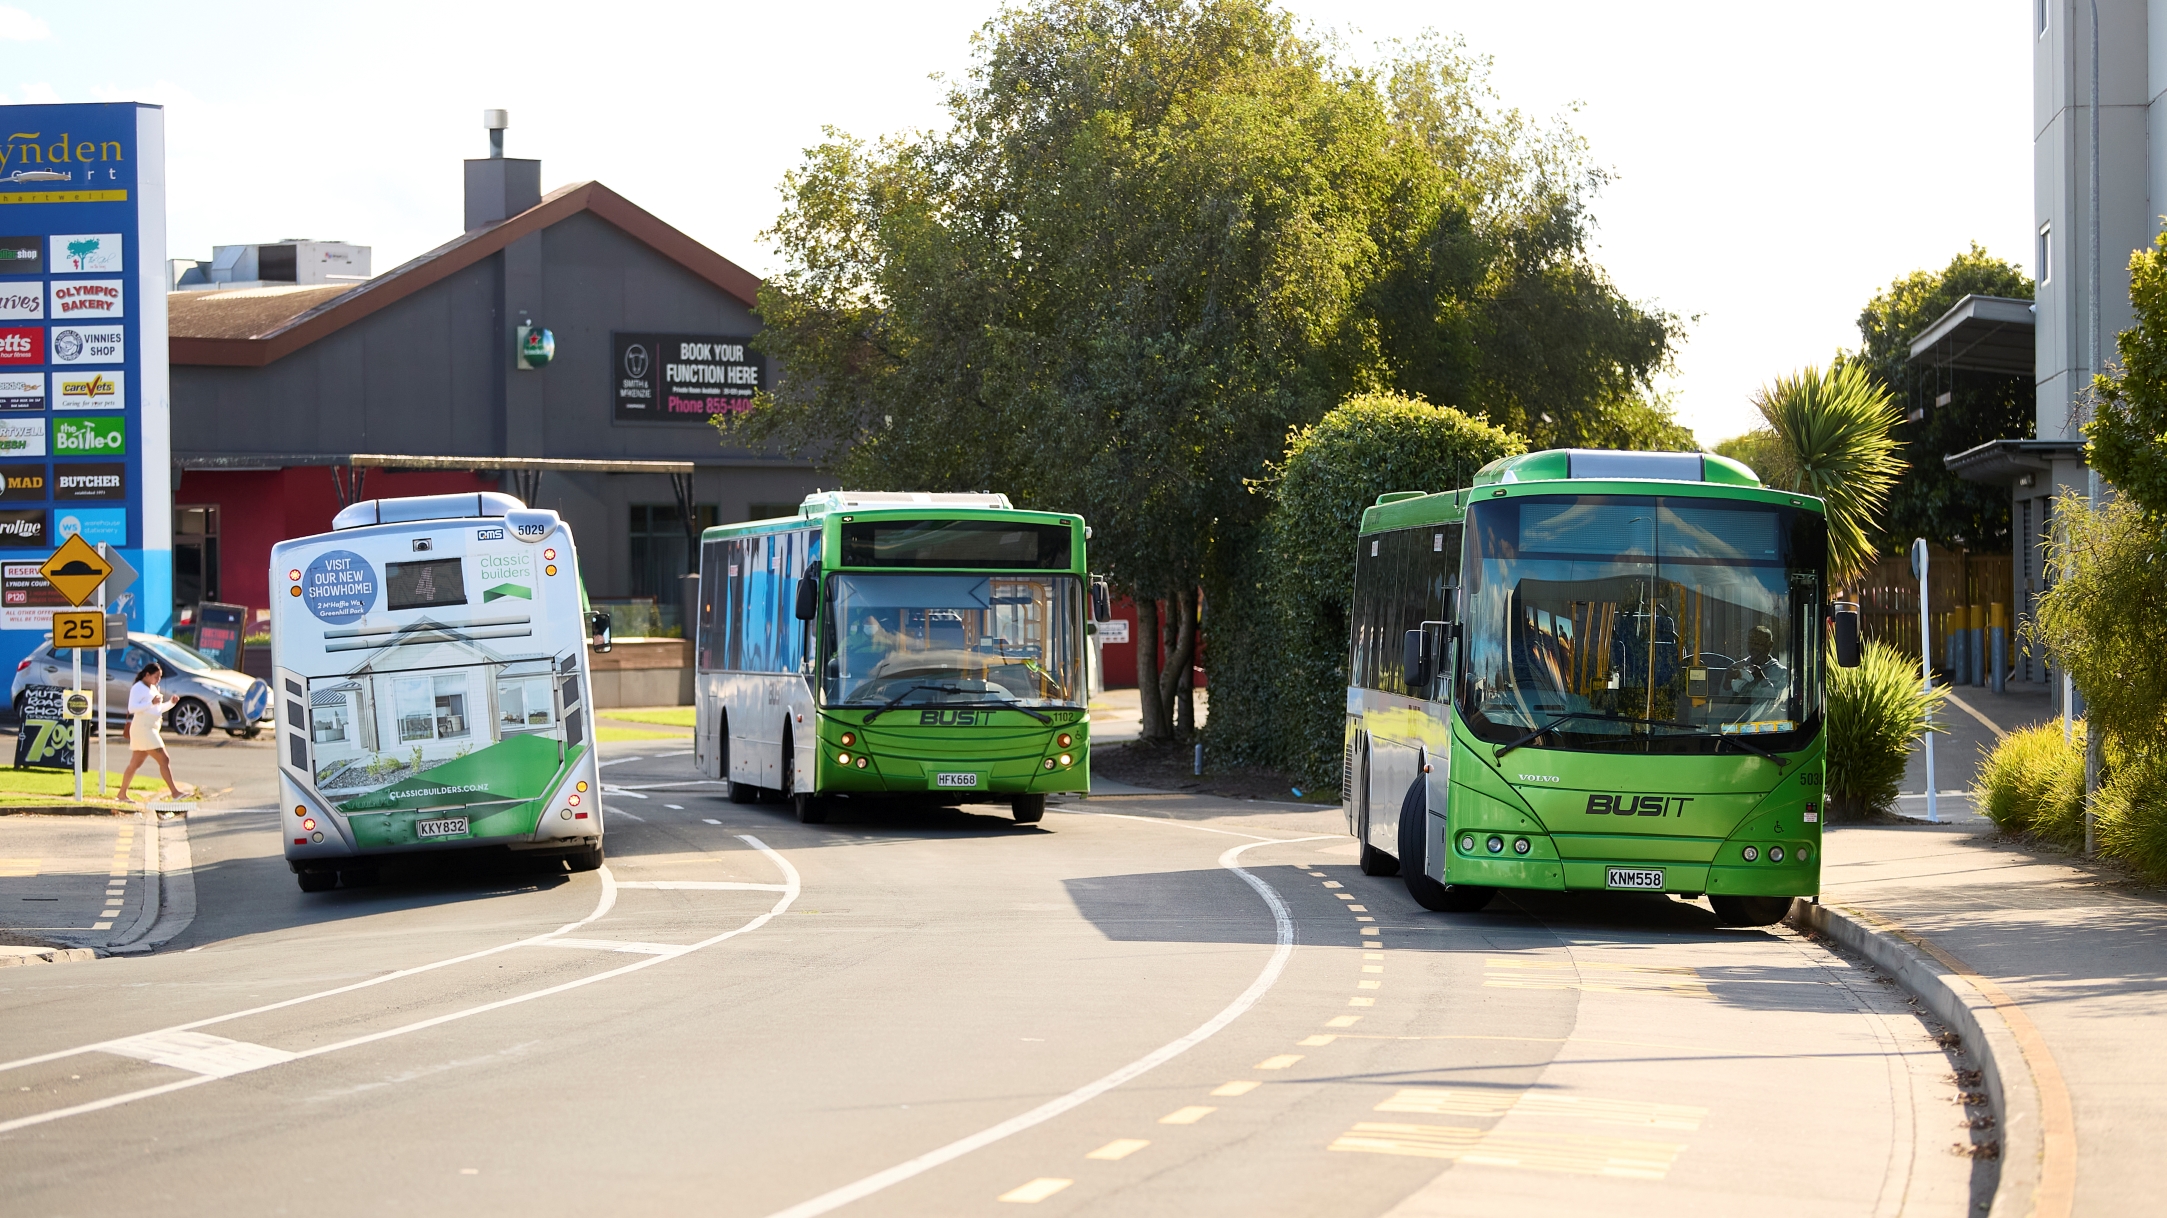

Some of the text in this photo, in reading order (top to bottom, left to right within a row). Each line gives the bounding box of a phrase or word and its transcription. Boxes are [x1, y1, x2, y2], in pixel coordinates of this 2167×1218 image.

[11, 168, 117, 182] Curt
[55, 285, 119, 300] OLYMPIC
[61, 299, 114, 313] BAKERY
[84, 333, 121, 344] VINNIES
[90, 346, 116, 356] SHOP
[680, 342, 744, 363] BOOK YOUR
[666, 363, 758, 385] FUNCTION HERE
[622, 379, 644, 388] SMITH
[668, 395, 704, 413] Phone
[60, 422, 77, 433] the
[7, 477, 43, 489] MAD
[59, 475, 120, 488] BUTCHER
[62, 523, 78, 532] WS
[518, 524, 545, 536] 5029
[478, 529, 503, 540] QMS
[325, 558, 351, 571] VISIT
[480, 553, 530, 568] classic
[8, 567, 41, 576] RESERV
[315, 570, 364, 585] OUR NEW
[481, 566, 531, 580] builders
[5, 580, 30, 588] LYNDEN
[309, 582, 373, 598] SHOWHOME!
[415, 566, 437, 601] 4
[7, 593, 25, 602] P120
[319, 607, 364, 617] Greenhill Park
[63, 619, 94, 640] 25
[25, 689, 64, 699] MUTT
[919, 710, 997, 726] BUSIT
[1053, 712, 1074, 722] 1102
[938, 774, 976, 785] HFK668
[1518, 774, 1560, 783] VOLVO
[389, 783, 489, 799] CLASSICBUILDERS.CO.NZ
[1585, 794, 1695, 818] BUSIT
[420, 820, 465, 835] KKY832
[1609, 871, 1662, 887] KNM558
